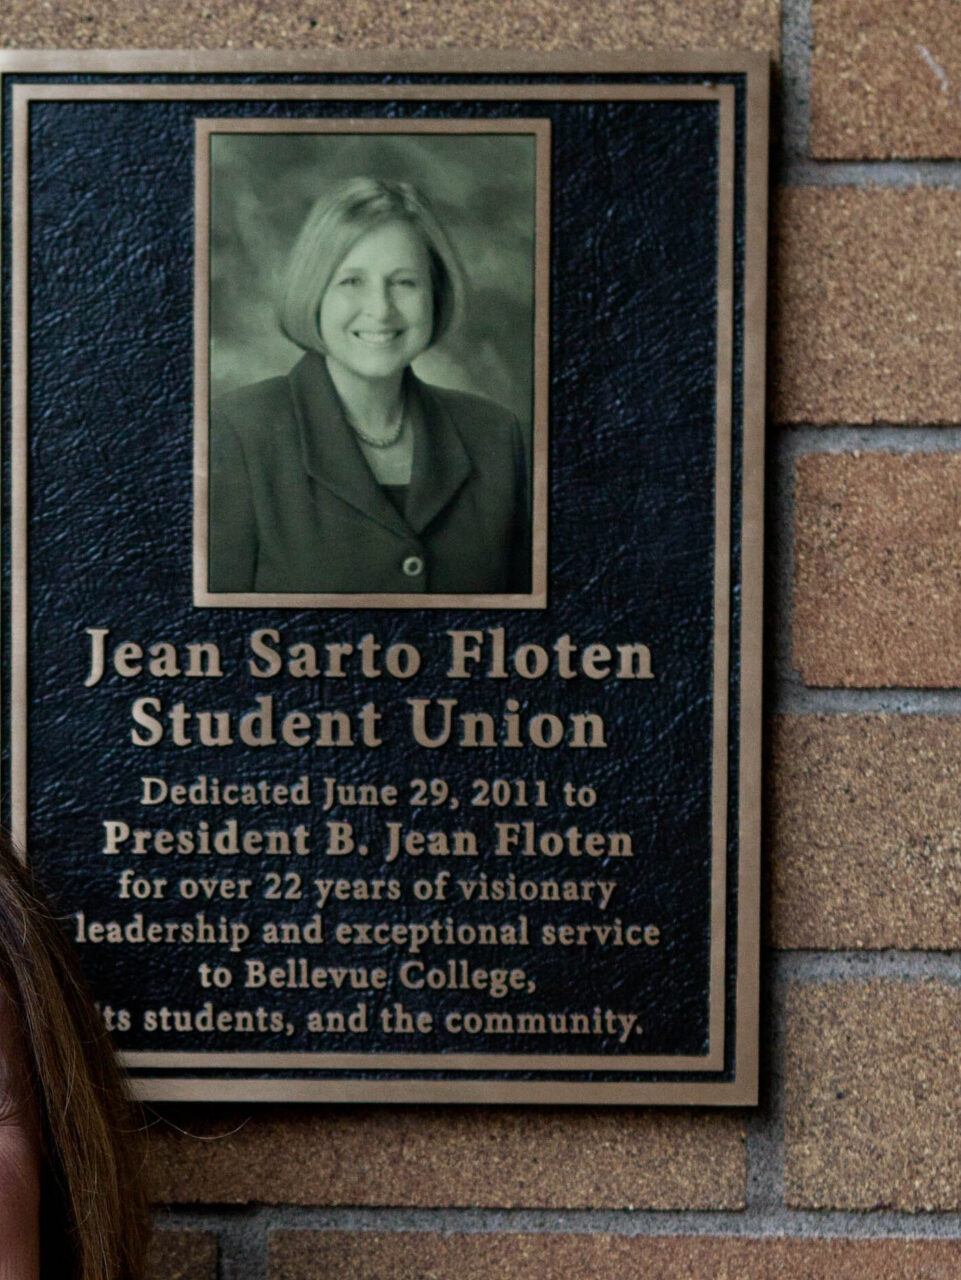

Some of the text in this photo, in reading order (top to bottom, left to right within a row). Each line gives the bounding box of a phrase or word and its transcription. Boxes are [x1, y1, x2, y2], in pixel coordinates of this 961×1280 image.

[85, 627, 655, 688] Jean Sarto Floten
[131, 695, 607, 748] Student Union
[142, 775, 597, 810] Dedicated June 29, 2011 to
[104, 819, 633, 862] President B. Jean Floten
[120, 869, 617, 910] for over 22 years of visionary
[77, 913, 660, 953] leadership and exceptional service
[200, 958, 536, 998] to Bellevue College,
[144, 1002, 294, 1036] students,
[308, 1003, 368, 1033] and
[380, 1003, 433, 1033] the
[446, 1007, 643, 1043] community.
